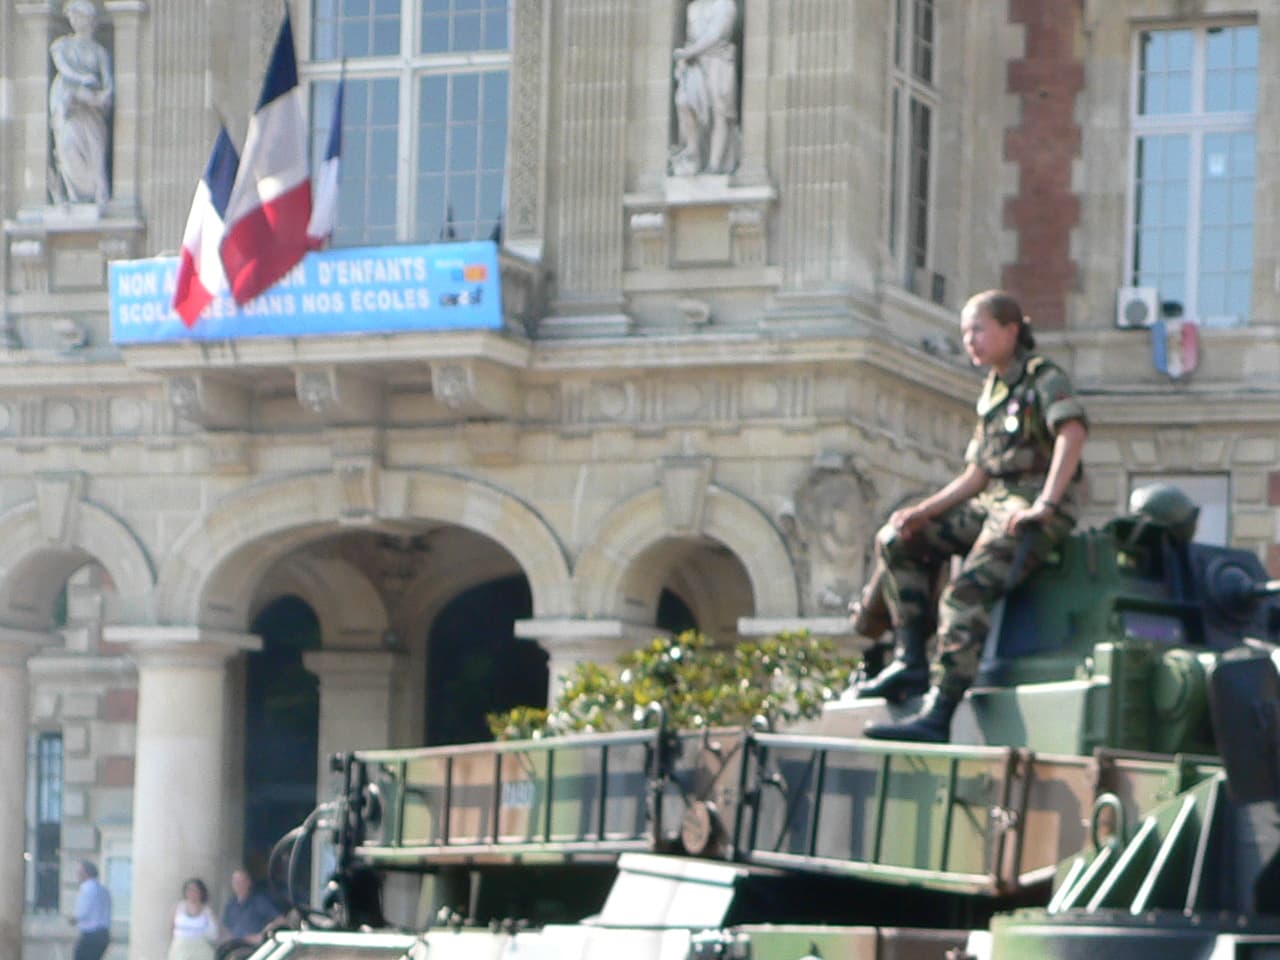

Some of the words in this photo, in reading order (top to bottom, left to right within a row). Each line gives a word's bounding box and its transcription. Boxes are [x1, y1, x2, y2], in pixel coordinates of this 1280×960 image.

[118, 271, 157, 297] NON
[318, 256, 427, 285] D'ENFANTS
[302, 291, 344, 314] NOS
